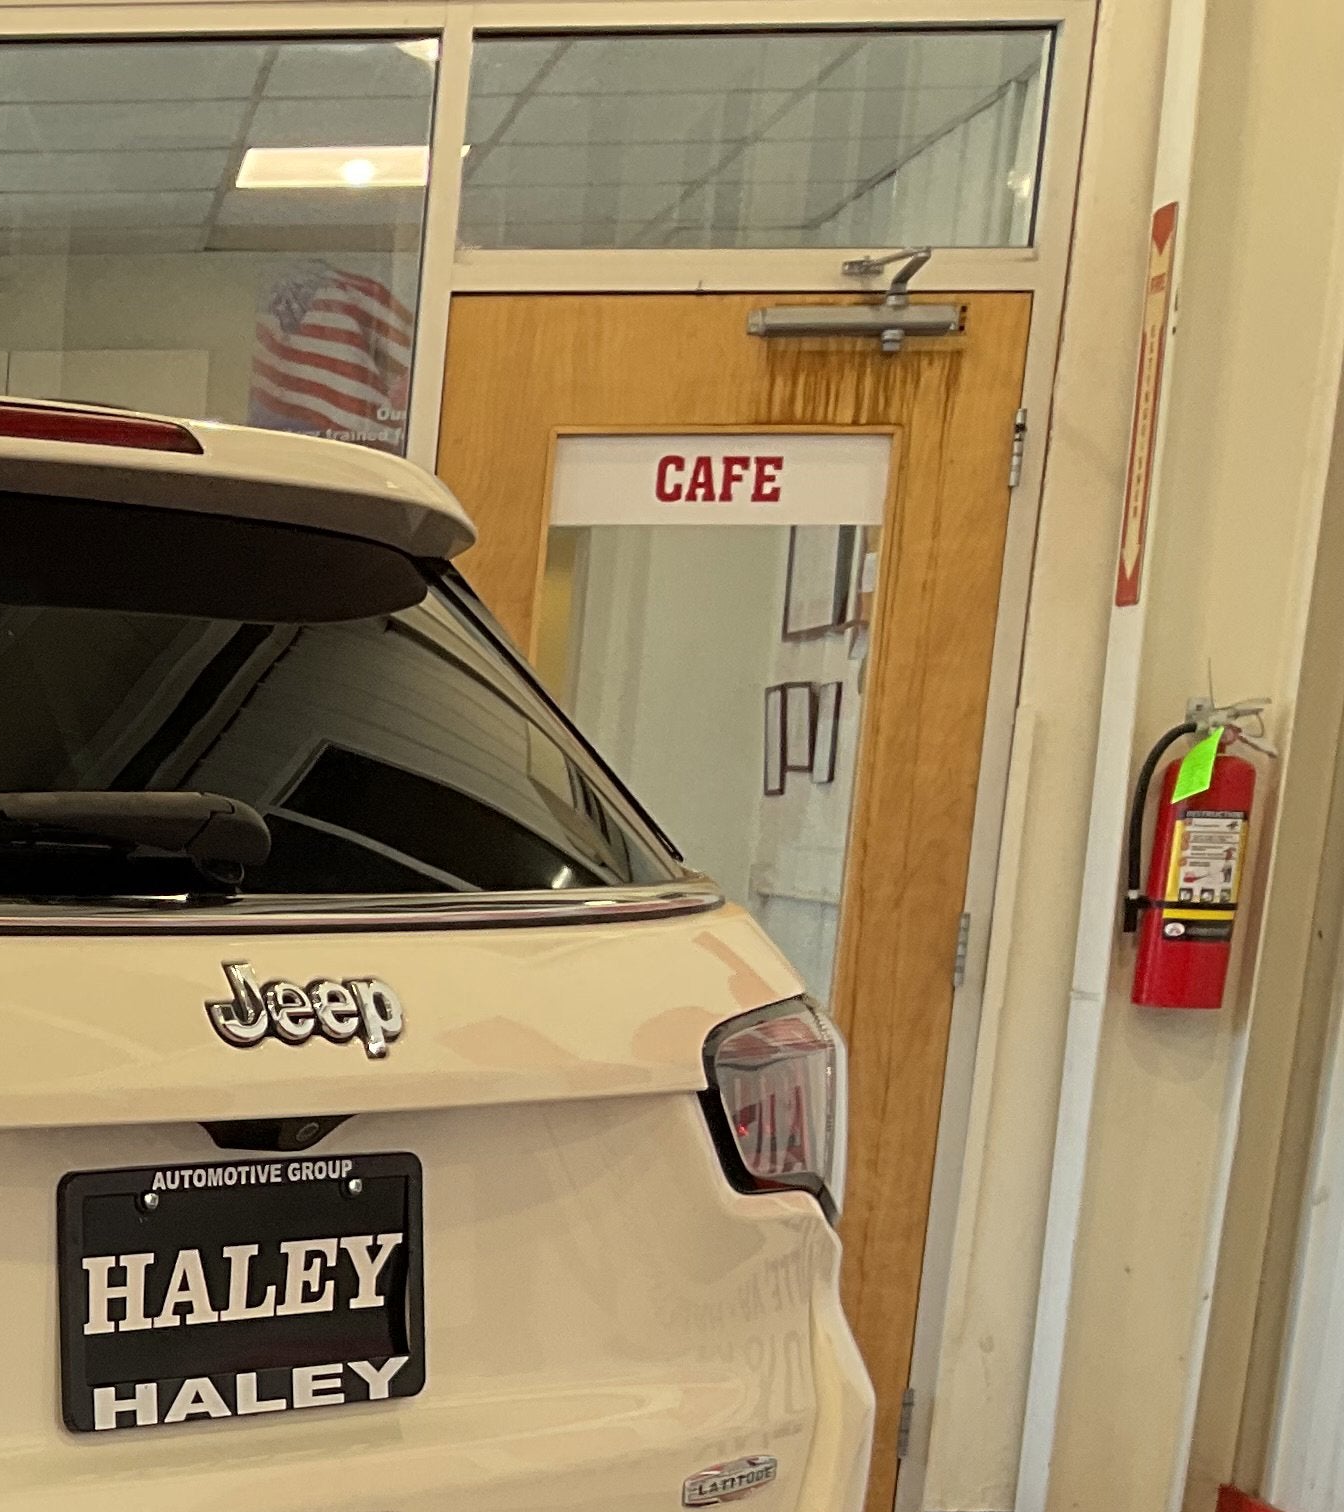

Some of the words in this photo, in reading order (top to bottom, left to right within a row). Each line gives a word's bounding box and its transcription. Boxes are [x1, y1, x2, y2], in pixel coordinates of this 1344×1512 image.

[655, 454, 784, 503] CAFE
[204, 960, 404, 1059] Jeep
[152, 1163, 282, 1191] AUTOMOTIVE
[287, 1159, 353, 1181] GROUP
[82, 1232, 403, 1335] HALEY
[93, 1356, 409, 1431] HALEY
